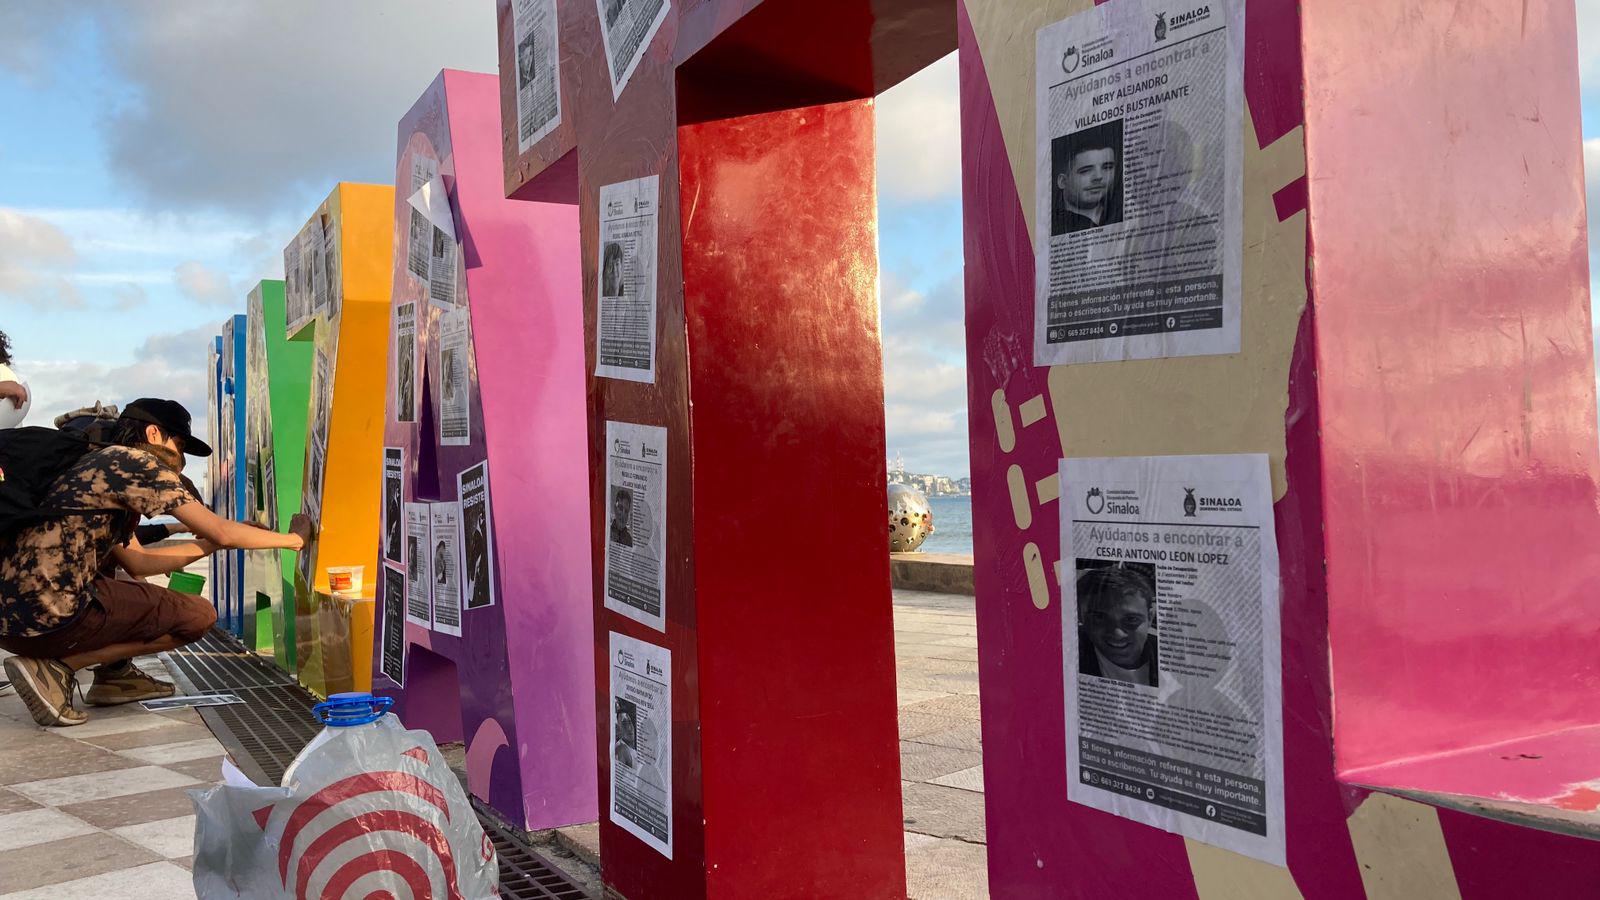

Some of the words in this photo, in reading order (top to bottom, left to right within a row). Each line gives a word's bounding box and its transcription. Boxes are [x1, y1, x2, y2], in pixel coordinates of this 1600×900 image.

[1170, 6, 1210, 26] SINALOA
[1082, 48, 1114, 68] Sinaloa
[1065, 73, 1121, 99] Ayúdanos
[1125, 67, 1132, 79] a
[1135, 46, 1198, 76] encontrar
[1202, 42, 1210, 55] a
[1092, 92, 1115, 107] NERY
[1117, 74, 1168, 100] ALEJANDRO
[1075, 105, 1124, 129] VILLALOBOS
[1126, 85, 1190, 113] BUSTAMANTE
[1050, 301, 1057, 309] Si
[1059, 298, 1079, 306] tienes
[1123, 288, 1155, 300] referente
[1165, 285, 1181, 294] esta
[1050, 311, 1067, 320] llama
[1113, 302, 1122, 311] Tu
[1123, 301, 1144, 312] ayuda
[1146, 300, 1155, 308] es
[1155, 298, 1173, 307] muy
[1174, 292, 1219, 306] importante.
[1067, 329, 1079, 337] 669
[1079, 327, 1089, 336] 327
[462, 475, 484, 495] SINALOA
[463, 490, 485, 509] RESISTE
[1107, 501, 1139, 515] Sinaloa
[1199, 498, 1242, 507] SINALOA
[1089, 526, 1149, 544] Ayúdanos
[1152, 532, 1160, 544] a
[1163, 532, 1231, 546] encontrar
[1235, 536, 1243, 547] a
[1096, 546, 1123, 559] CESAR
[1125, 549, 1167, 561] ANTONIO
[1170, 551, 1195, 563] LEON
[1198, 553, 1229, 565] LOPEZ
[1081, 740, 1089, 749] Si
[1091, 743, 1111, 755] tienes
[1160, 761, 1192, 776] referente
[1195, 770, 1201, 778] a
[1204, 772, 1222, 783] esta
[1081, 751, 1100, 763] llama
[1101, 757, 1106, 765] o
[1150, 768, 1159, 778] Tu
[1160, 773, 1183, 785] ayuda
[1184, 779, 1193, 787] es
[1195, 782, 1213, 795] muy
[1214, 787, 1262, 807] importante.
[1100, 776, 1112, 786] 669
[1112, 780, 1124, 790] 327
[1124, 783, 1141, 794] 8424
